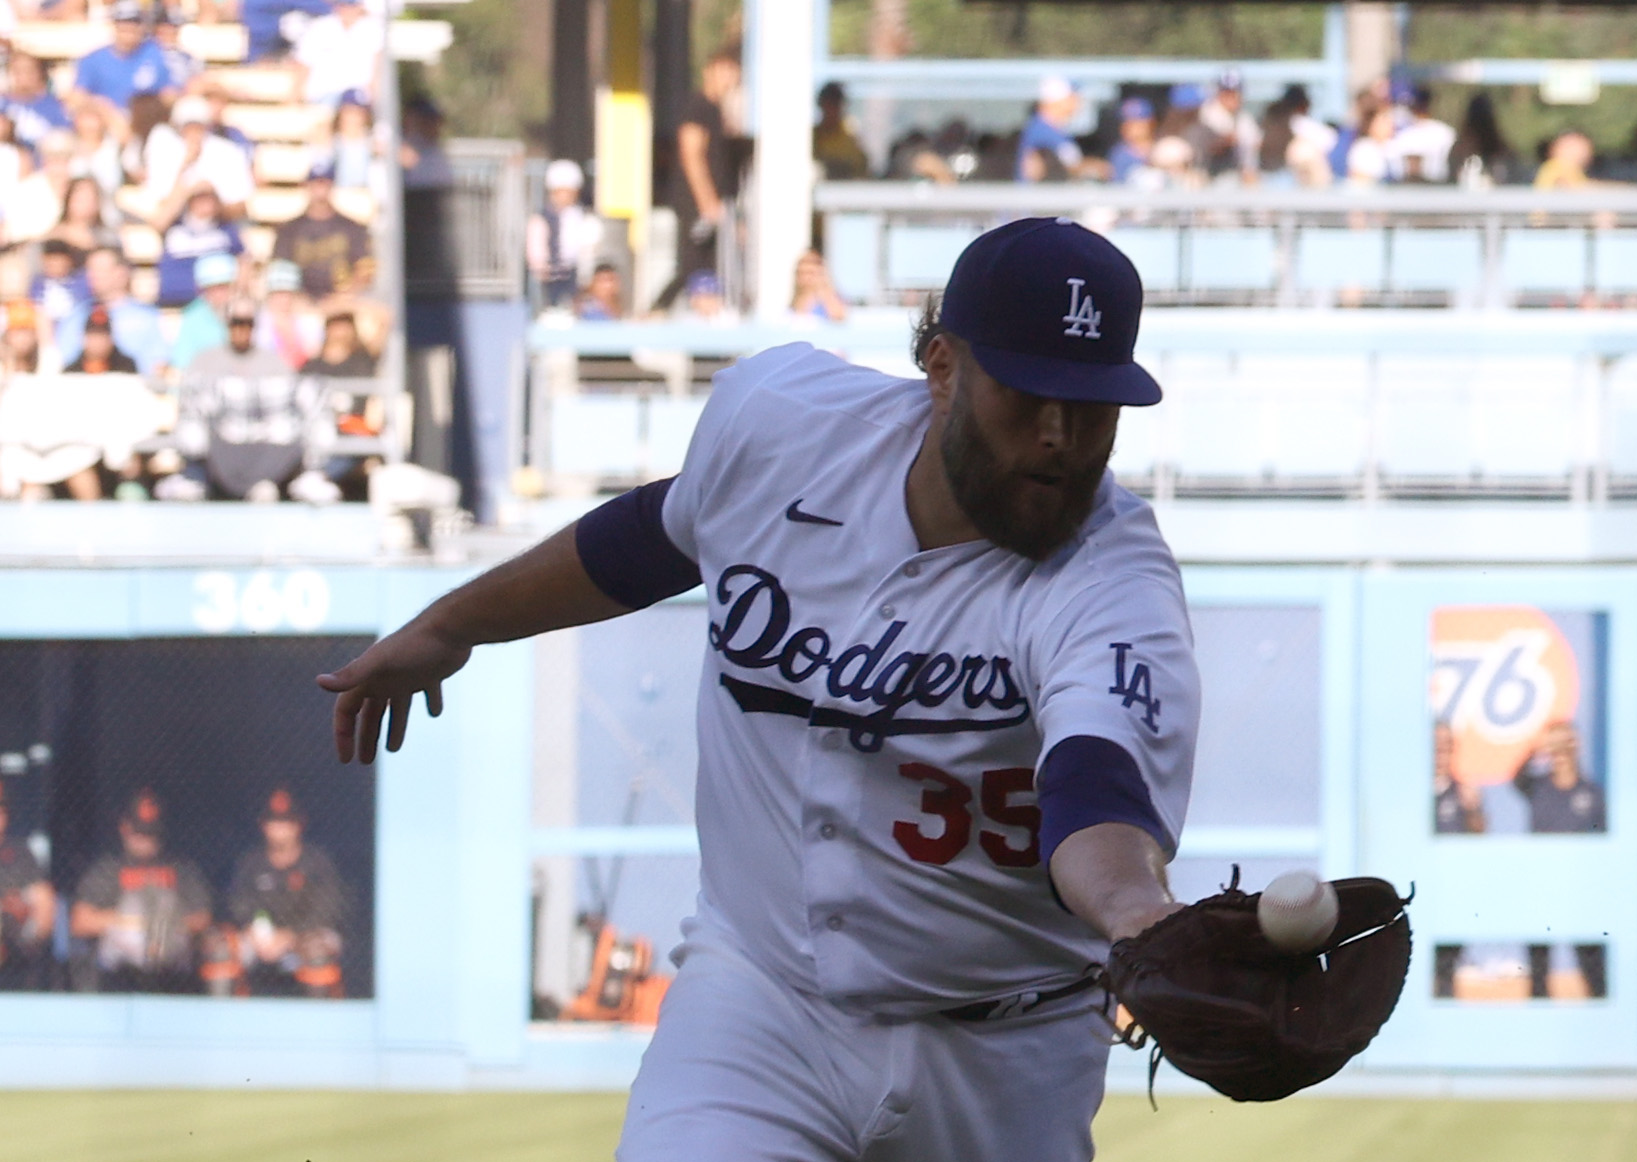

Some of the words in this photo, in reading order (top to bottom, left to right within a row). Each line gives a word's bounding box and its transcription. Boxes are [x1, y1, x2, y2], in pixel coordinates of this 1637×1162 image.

[1063, 277, 1102, 338] LA
[192, 570, 330, 632] 360
[709, 563, 1029, 753] Dodgers
[1108, 642, 1161, 734] LA
[1430, 638, 1546, 735] 76
[892, 762, 1042, 868] 35
